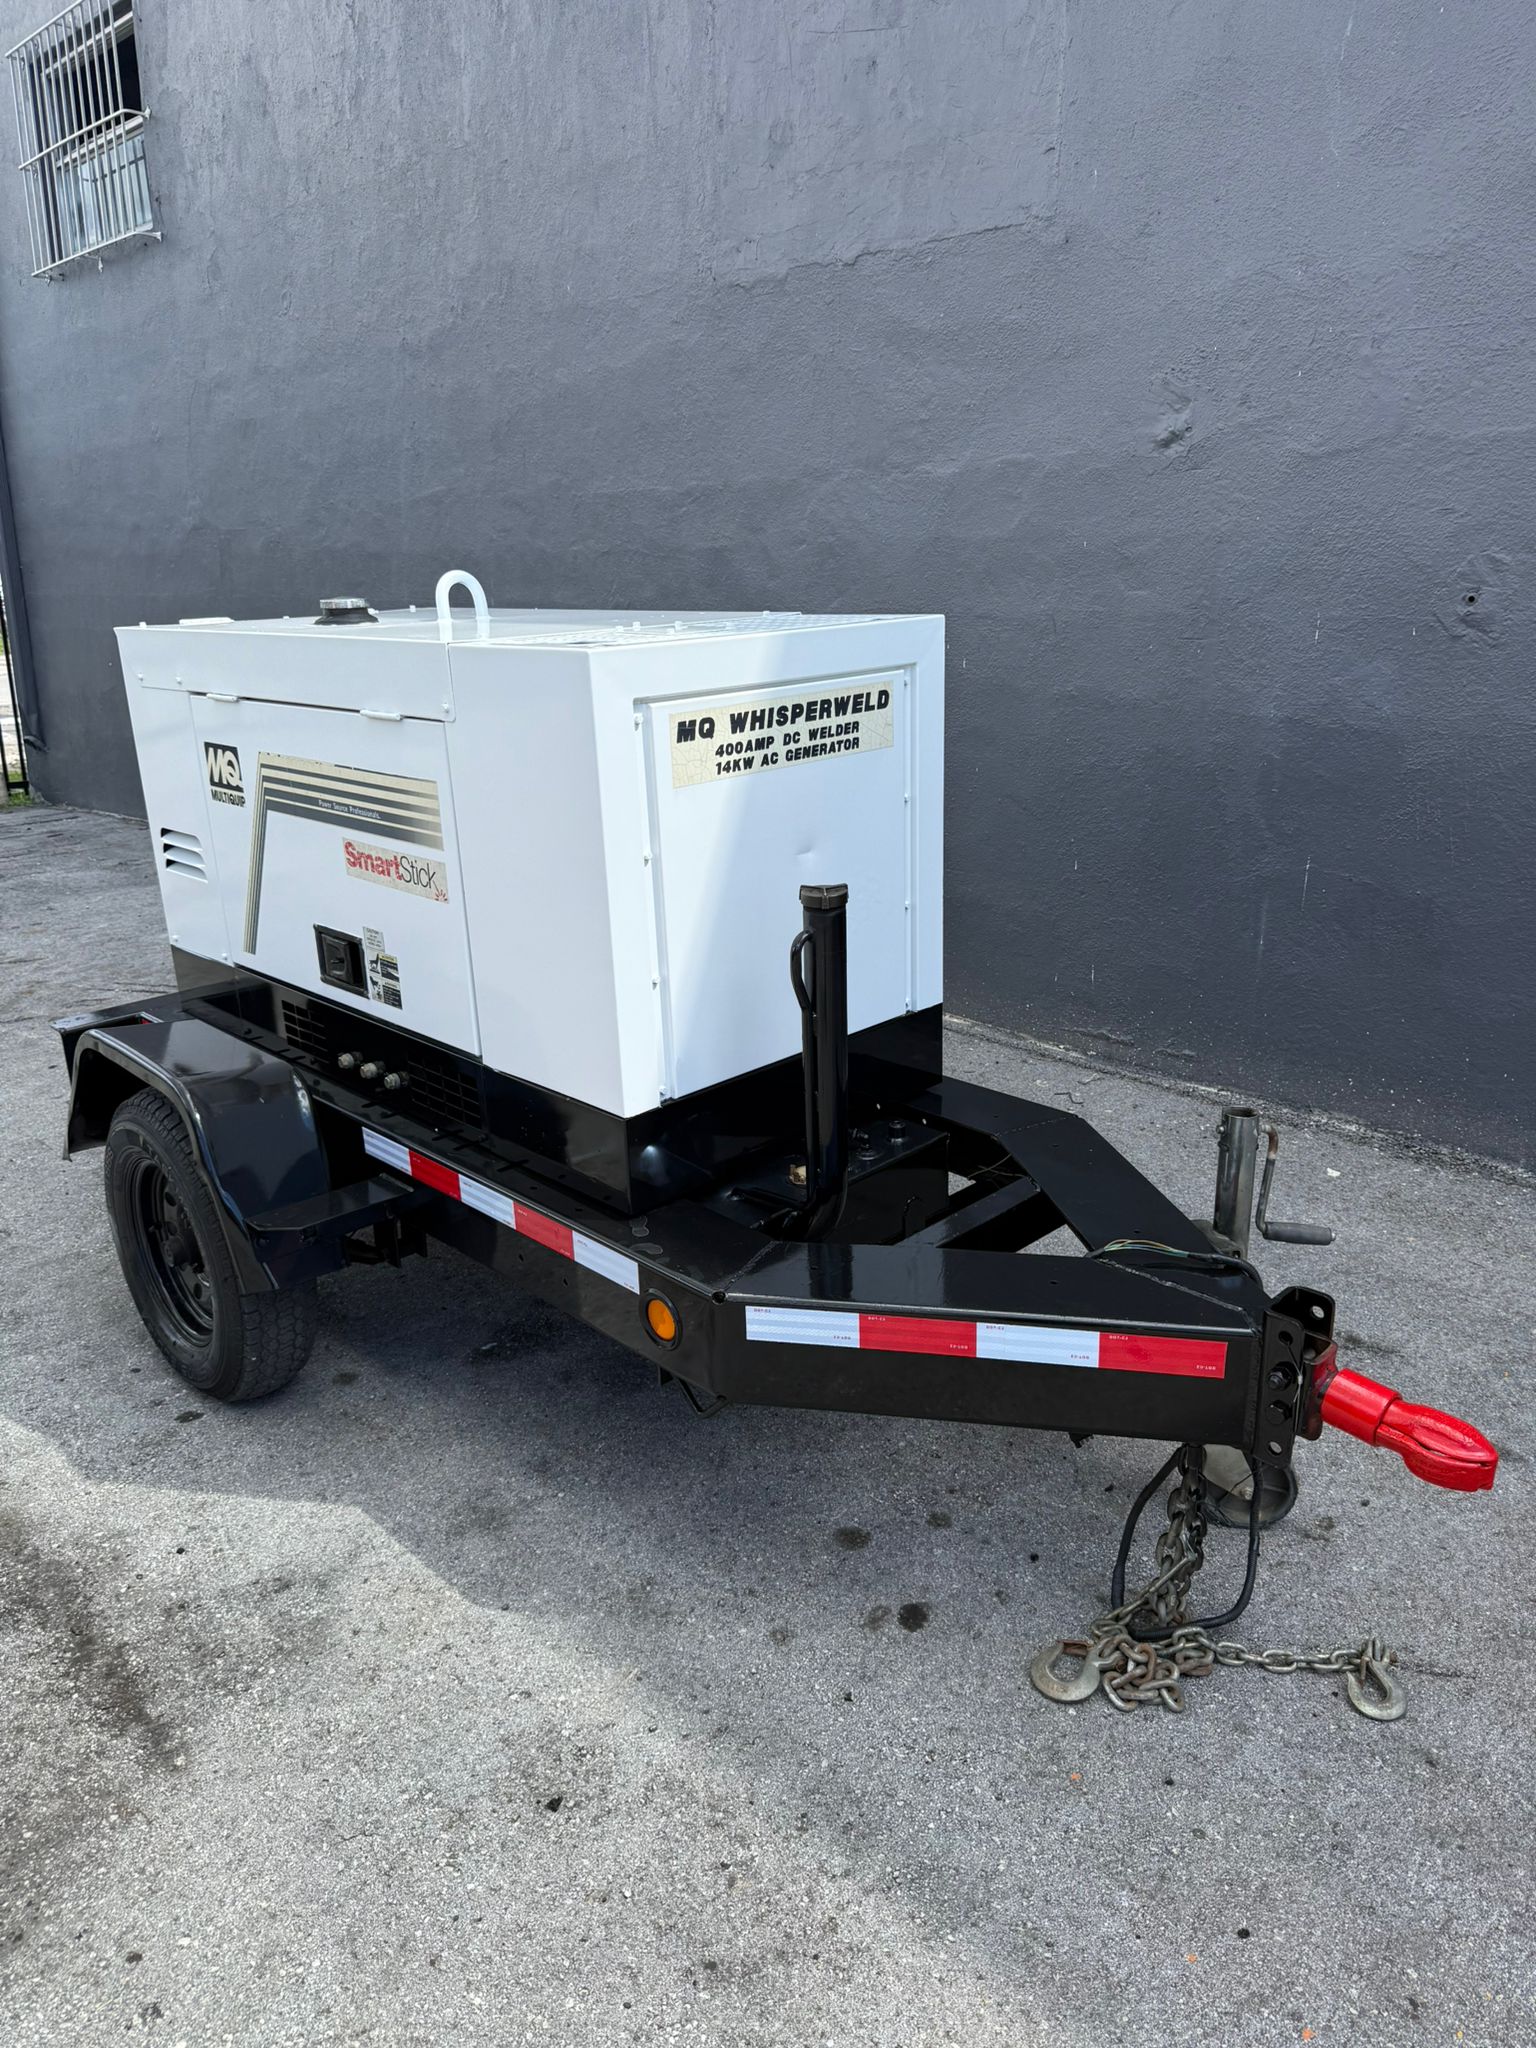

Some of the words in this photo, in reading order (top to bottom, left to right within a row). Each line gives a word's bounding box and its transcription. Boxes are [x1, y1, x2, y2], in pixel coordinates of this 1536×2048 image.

[676, 717, 715, 744] MQ
[730, 689, 890, 734] WHISPERWELD
[715, 736, 775, 758] 400AMP
[783, 731, 801, 746] DC
[808, 721, 860, 742] WELDER
[715, 756, 755, 775] 14KW
[760, 752, 779, 768] AC
[785, 736, 860, 761] GENERATOR
[207, 746, 243, 789] MQ
[211, 788, 246, 808] MULTIQUIP
